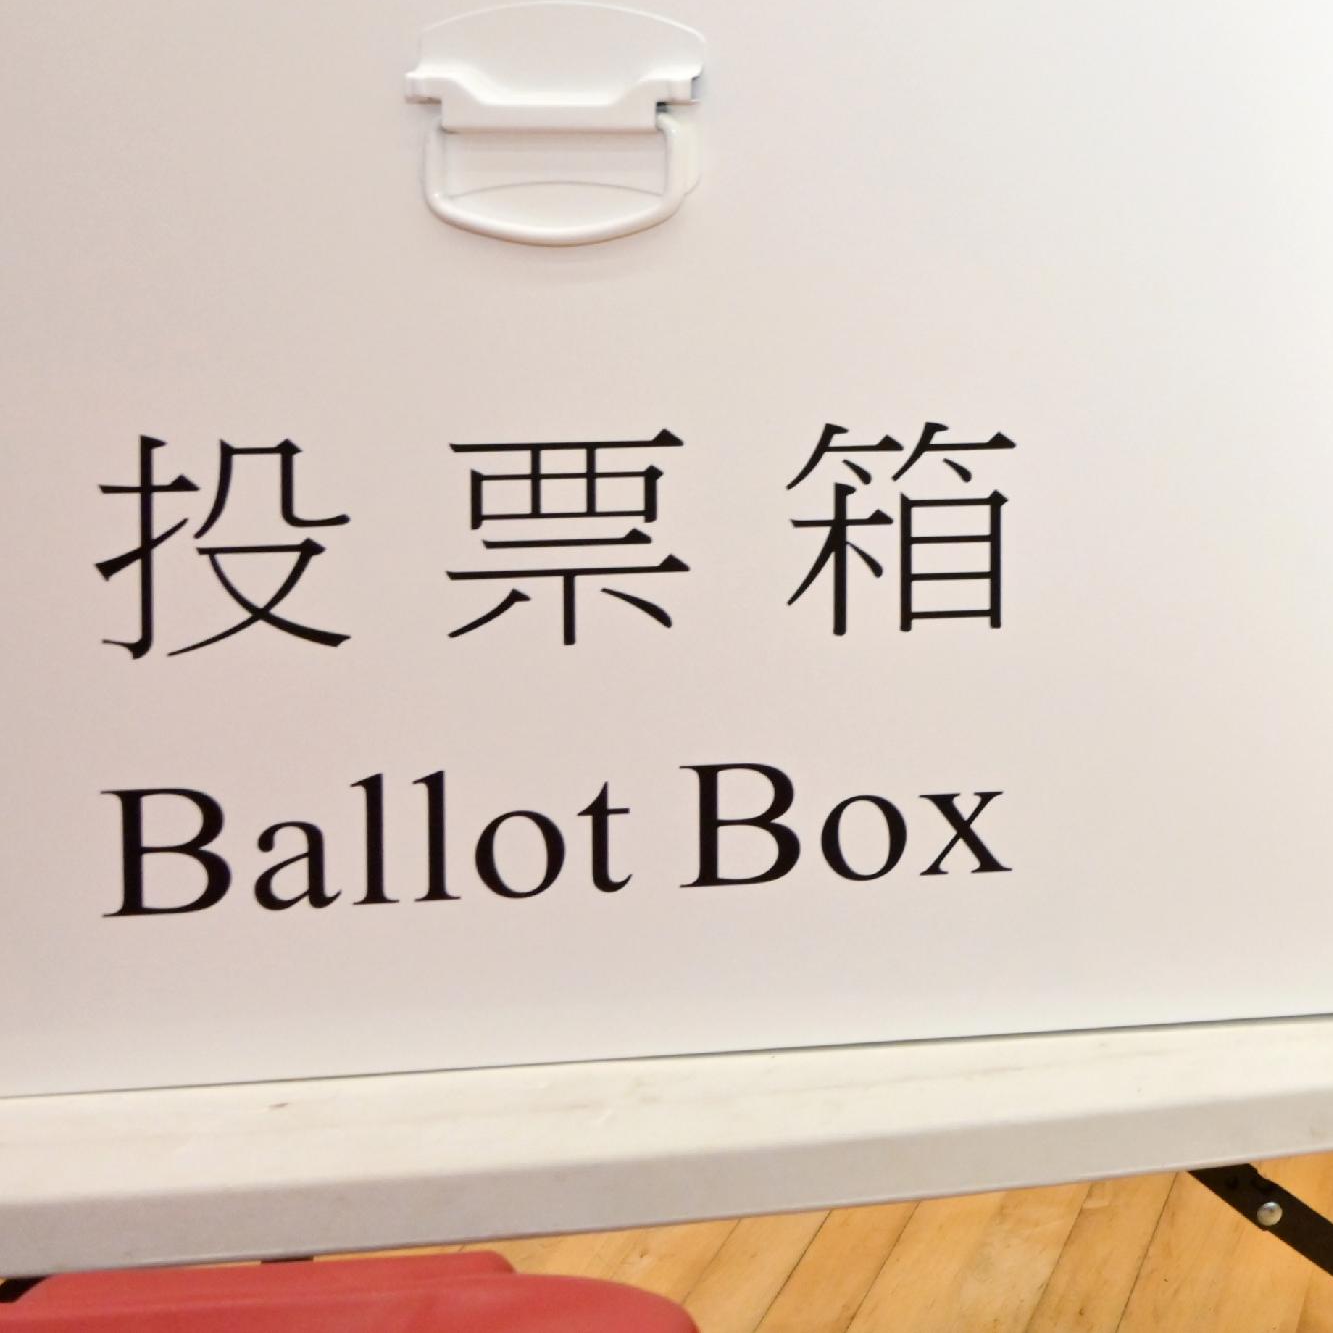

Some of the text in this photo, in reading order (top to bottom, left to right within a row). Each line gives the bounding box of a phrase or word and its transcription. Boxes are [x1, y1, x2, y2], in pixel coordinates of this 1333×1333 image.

[94, 422, 1017, 660] 投票箱
[100, 761, 1013, 919] Ballot Box
